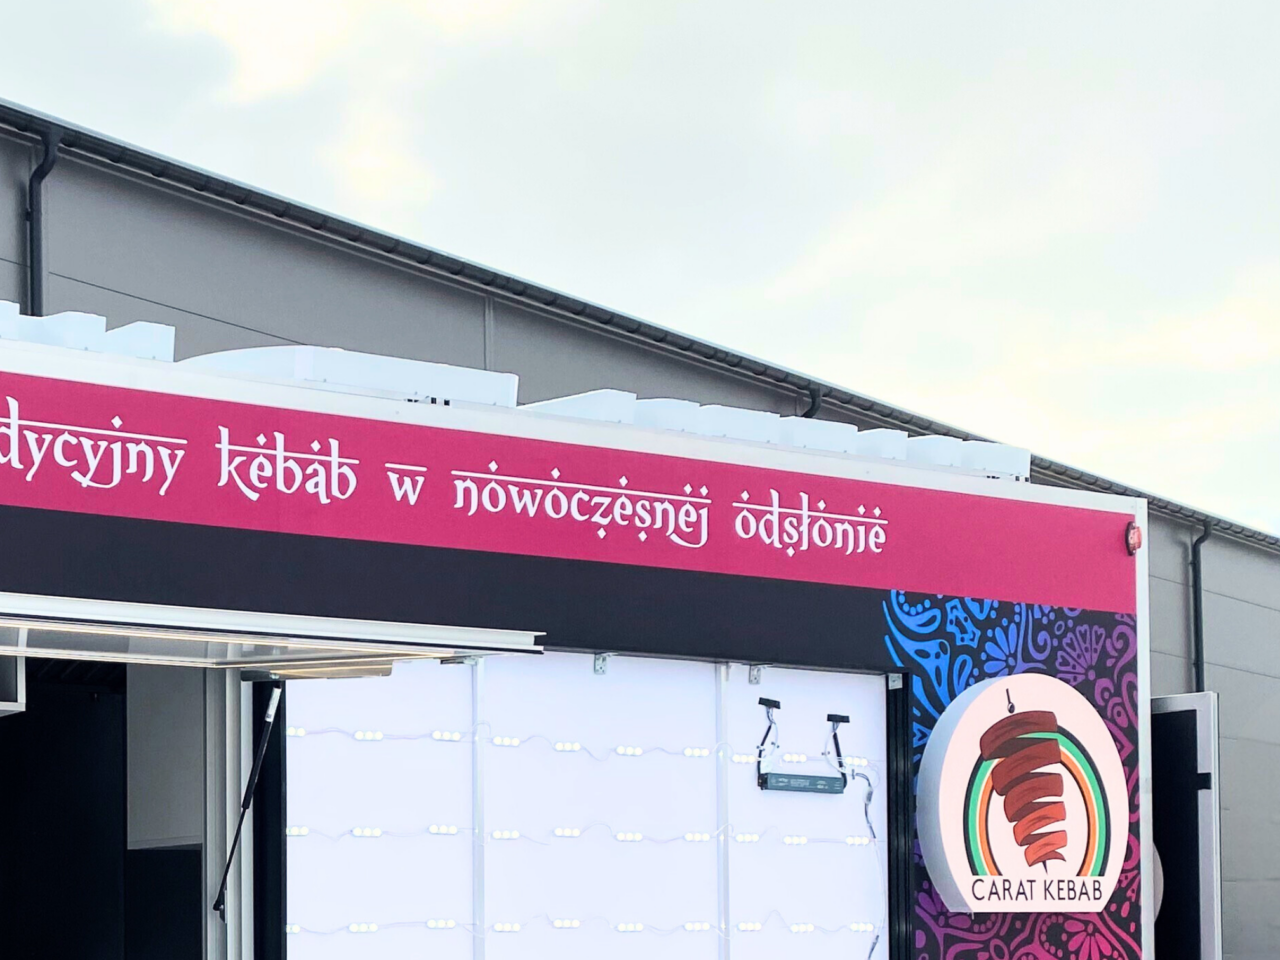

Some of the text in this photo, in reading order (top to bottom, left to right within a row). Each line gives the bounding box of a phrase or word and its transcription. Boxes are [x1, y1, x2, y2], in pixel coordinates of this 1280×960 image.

[215, 426, 359, 504] kebab
[385, 463, 427, 505] w
[451, 461, 711, 547] nowoczesnej
[733, 489, 888, 556] odsłonie
[972, 878, 1103, 901] CARAT KEBAB
